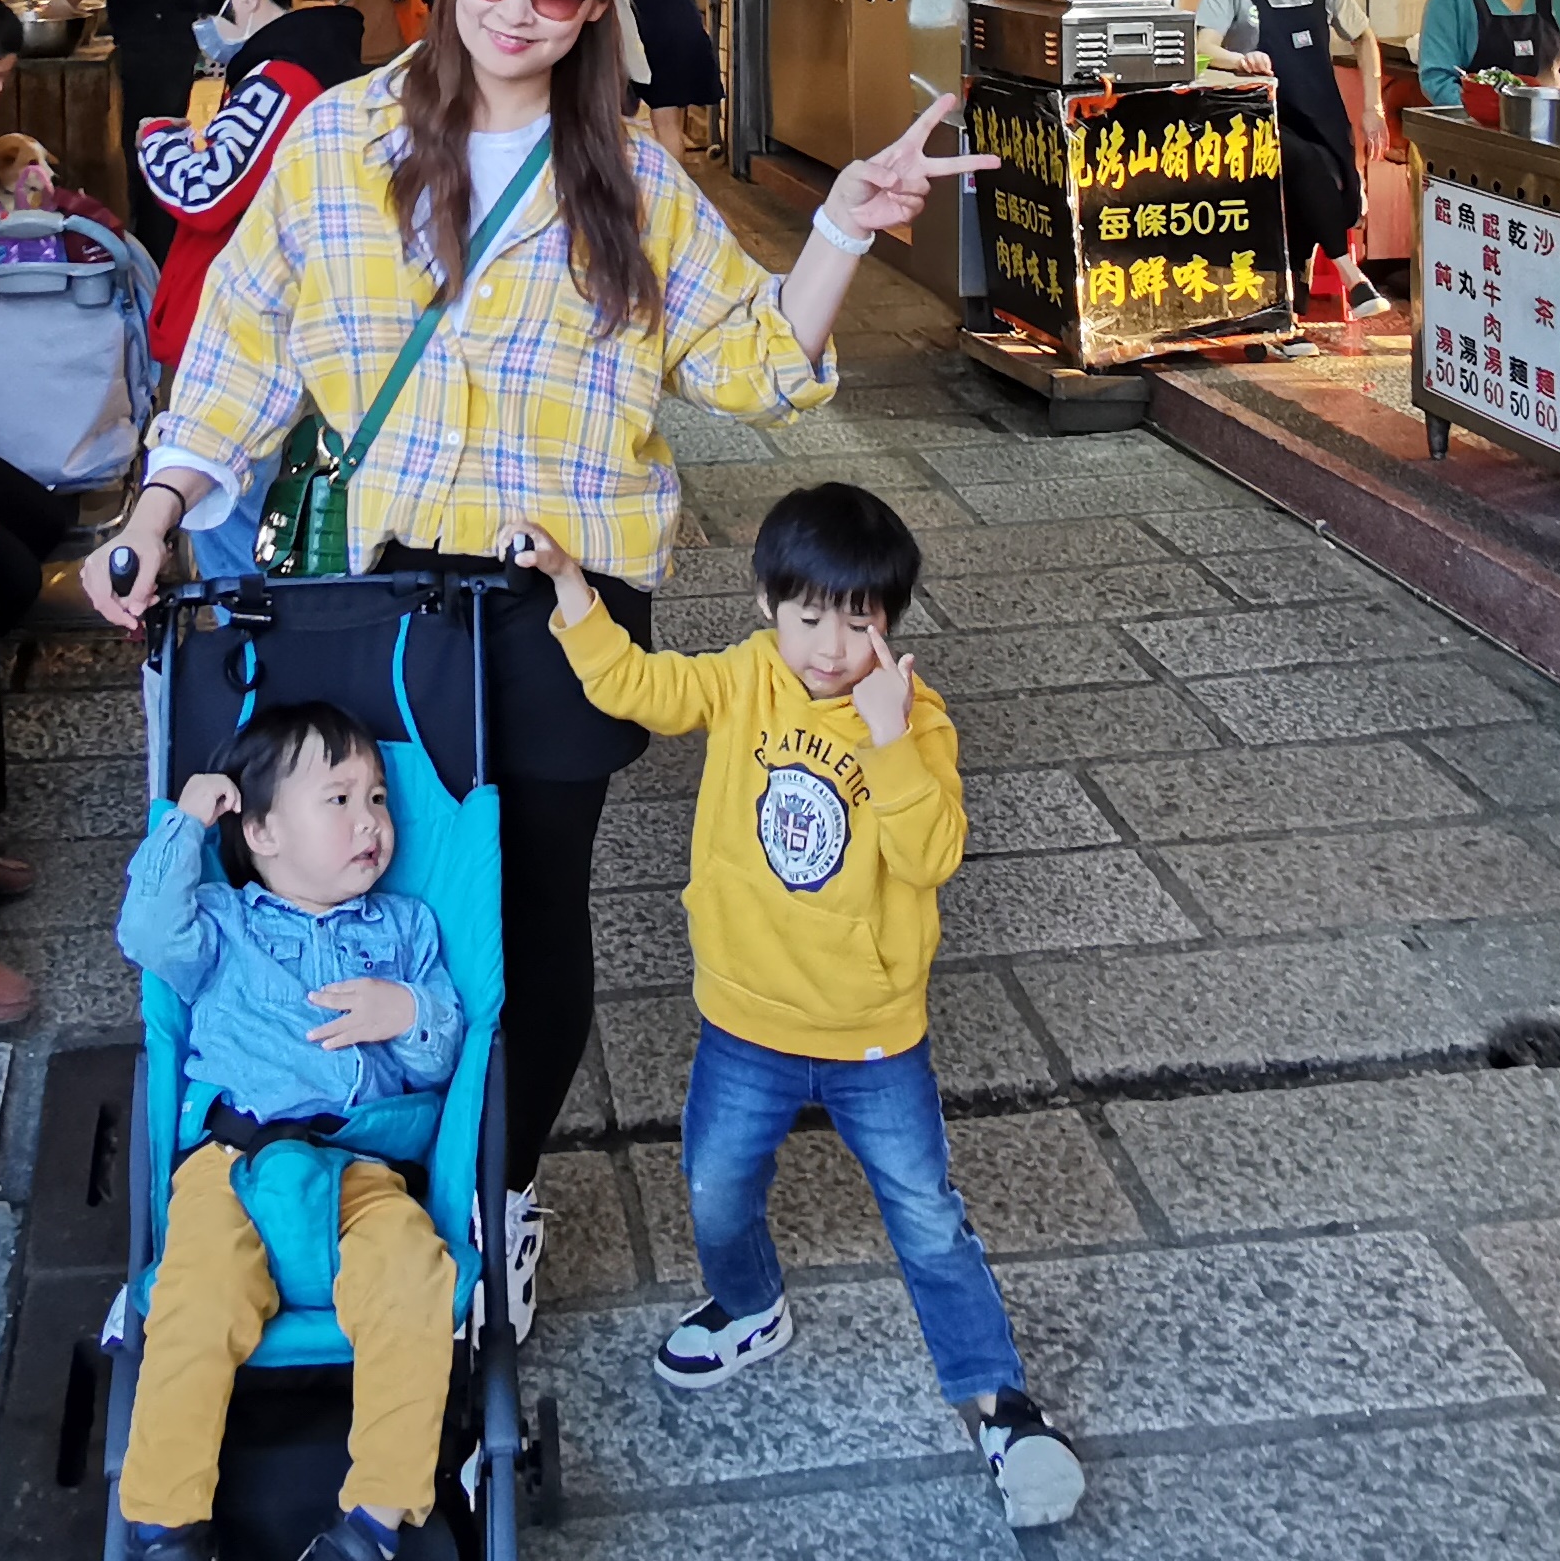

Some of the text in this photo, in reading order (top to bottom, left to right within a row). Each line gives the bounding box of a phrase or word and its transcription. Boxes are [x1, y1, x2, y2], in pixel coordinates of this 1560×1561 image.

[1098, 199, 1250, 241] 每條50元
[1089, 250, 1266, 307] 肉鮮味美
[1457, 202, 1480, 398] 魚丸湯 50
[1532, 225, 1558, 434] 沙茶麵 60
[1435, 356, 1456, 388] 50
[1483, 379, 1505, 410] 60
[1509, 389, 1531, 421] 50
[778, 727, 871, 808] ATHLETIC
